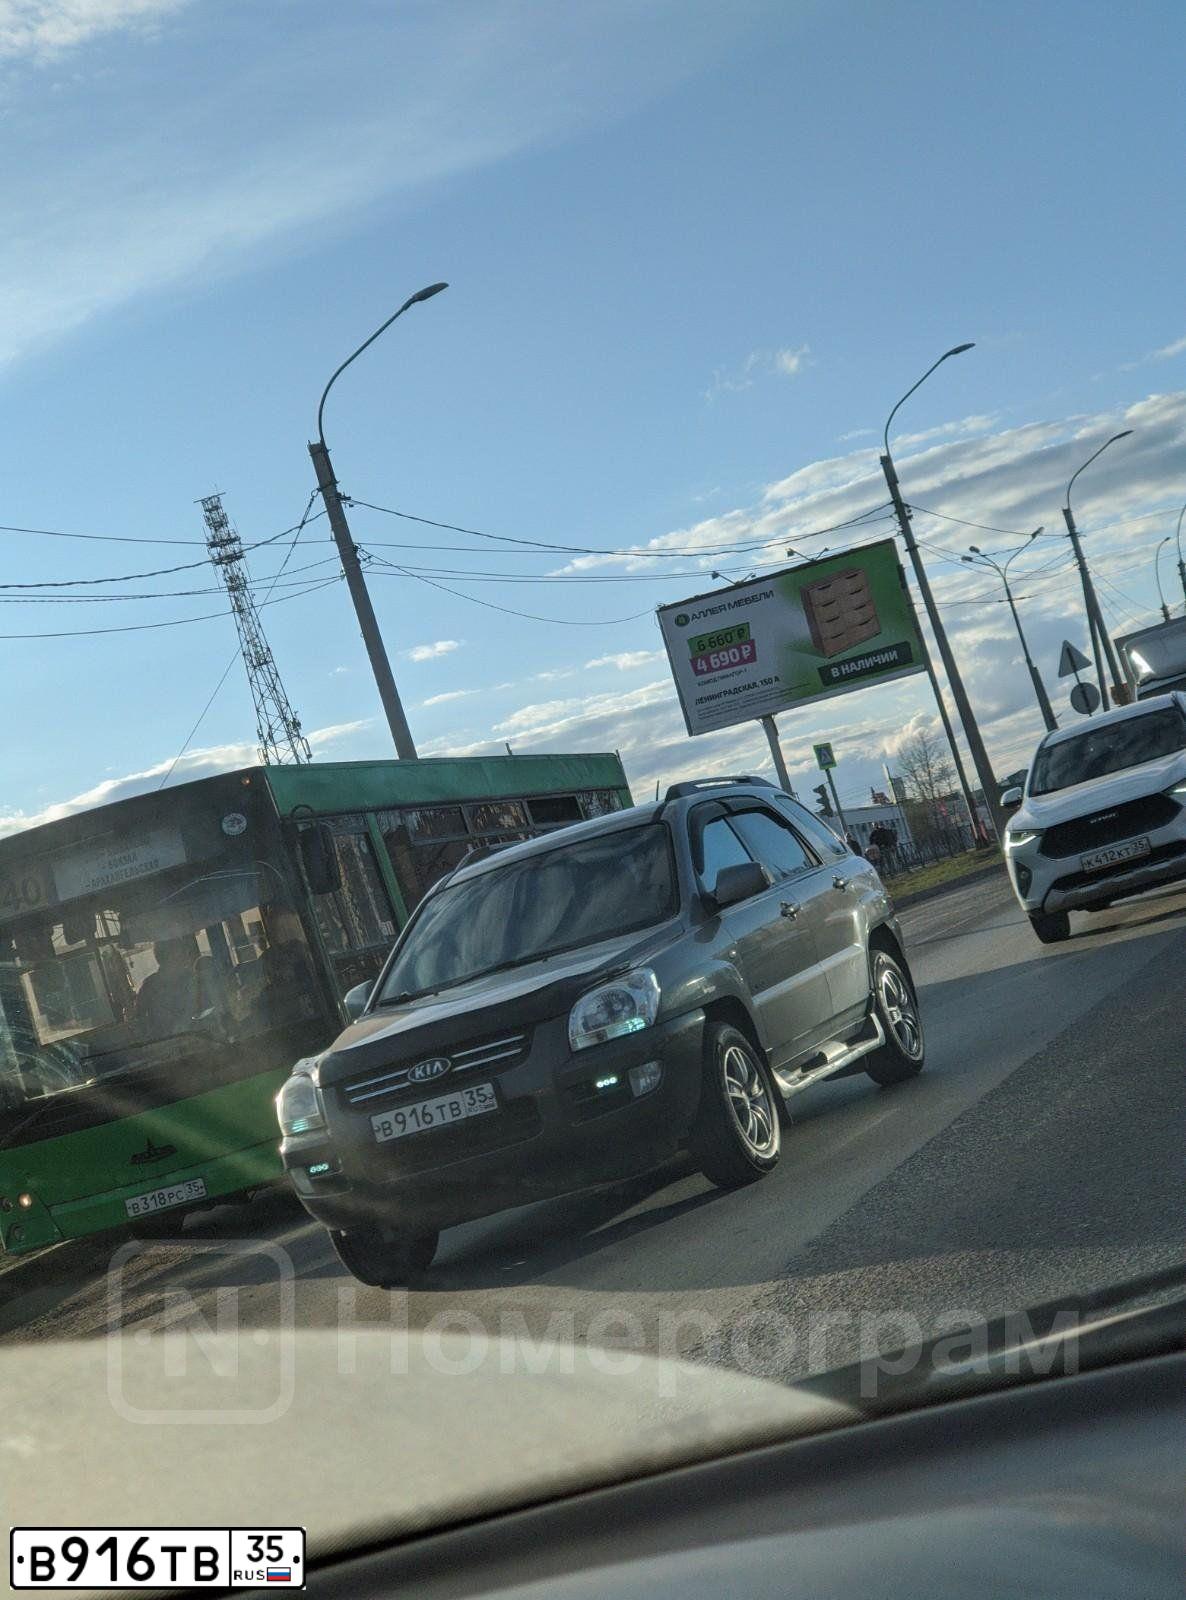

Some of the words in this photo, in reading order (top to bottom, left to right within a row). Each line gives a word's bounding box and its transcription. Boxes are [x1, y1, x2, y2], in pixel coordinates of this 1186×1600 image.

[691, 605, 726, 622] АЛЛЕЯ
[728, 590, 774, 611] МЕБЕЛИ
[697, 658, 707, 672] 4
[710, 648, 740, 669] 690
[831, 667, 840, 677] В
[841, 650, 898, 675] НАЛИЧИИ
[415, 1061, 443, 1079] KIA
[381, 1101, 461, 1137] В916ТВ
[464, 1087, 487, 1106] 35
[132, 1191, 184, 1213] В318РС
[186, 1182, 199, 1193] 35
